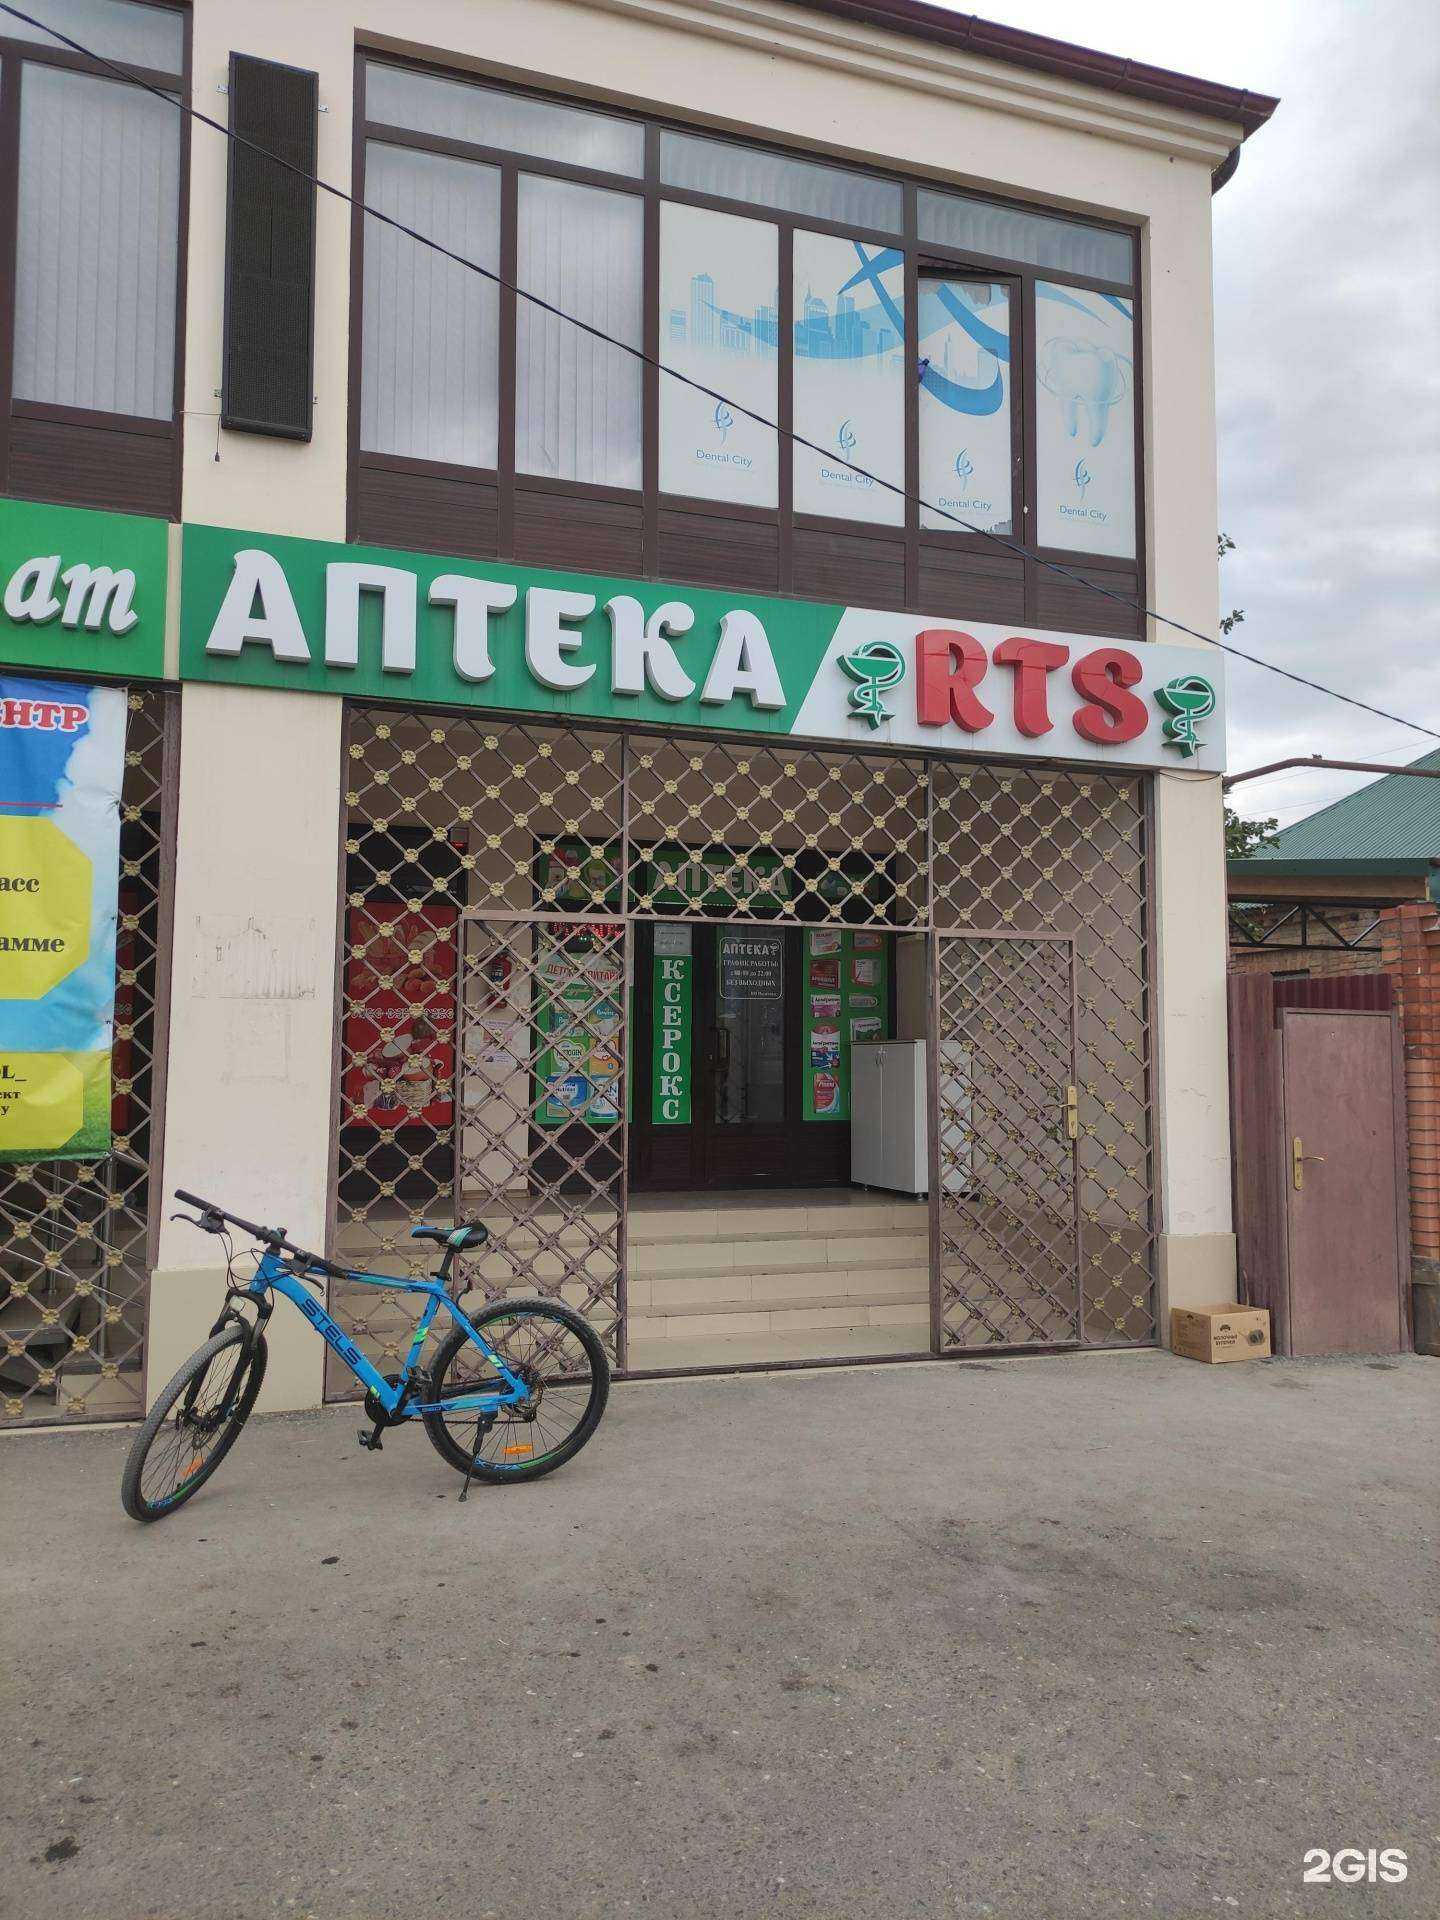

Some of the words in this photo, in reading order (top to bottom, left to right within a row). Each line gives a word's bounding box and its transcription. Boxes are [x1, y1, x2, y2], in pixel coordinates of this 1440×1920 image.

[696, 449, 729, 463] Dental
[732, 454, 752, 468] City
[821, 468, 851, 482] Dental
[855, 474, 874, 488] City
[938, 497, 970, 508] Dental
[972, 500, 992, 512] City
[1059, 505, 1088, 517] Dental
[1090, 508, 1108, 521] City
[205, 549, 787, 710] АПТЕКА
[915, 629, 1149, 744] RTS
[0, 700, 88, 731] НТР
[652, 859, 790, 897] АПТЕКА
[723, 943, 770, 955] АПТЕКА
[723, 959, 749, 967] ГРАФИК
[738, 979, 776, 987] ВЫХОДНЫХ
[659, 959, 685, 1120] КСЕРОКС
[302, 1298, 362, 1365] STELS
